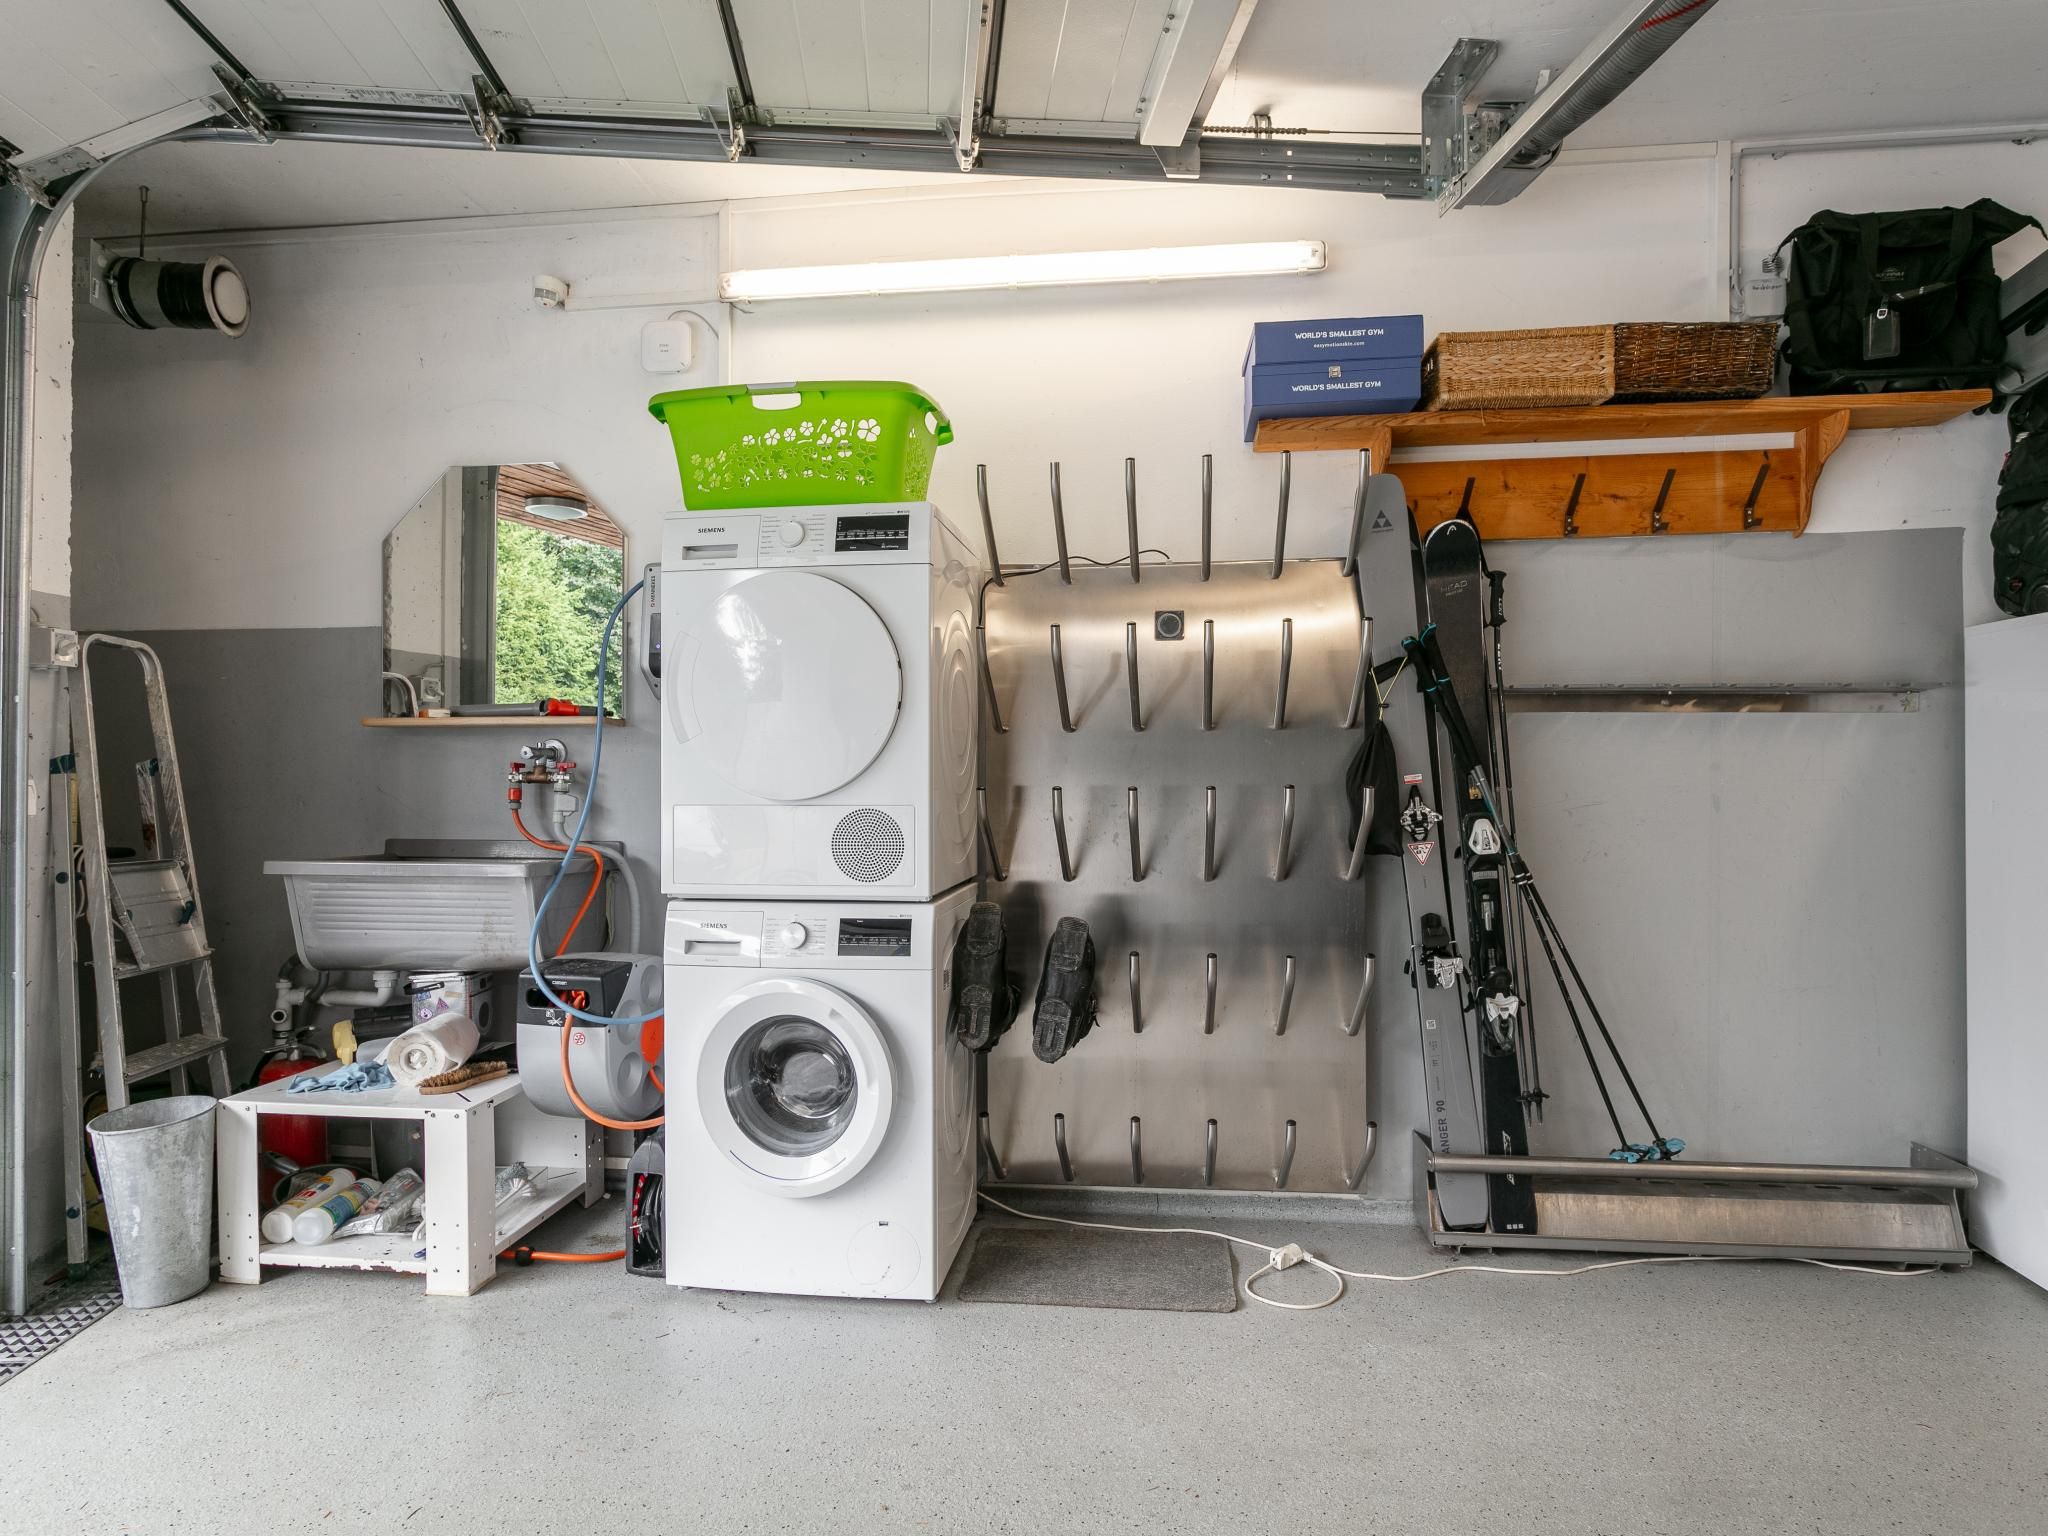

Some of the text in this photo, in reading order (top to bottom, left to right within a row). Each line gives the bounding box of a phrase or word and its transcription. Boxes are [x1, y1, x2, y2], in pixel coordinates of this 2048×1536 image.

[1295, 331, 1327, 339] WORLD'S
[1329, 329, 1366, 337] SMALLEST
[1292, 384, 1325, 392] WORLD'S
[1326, 382, 1364, 390] SMALLEST
[1436, 1100, 1445, 1113] 90
[1437, 1118, 1450, 1153] ANGER
